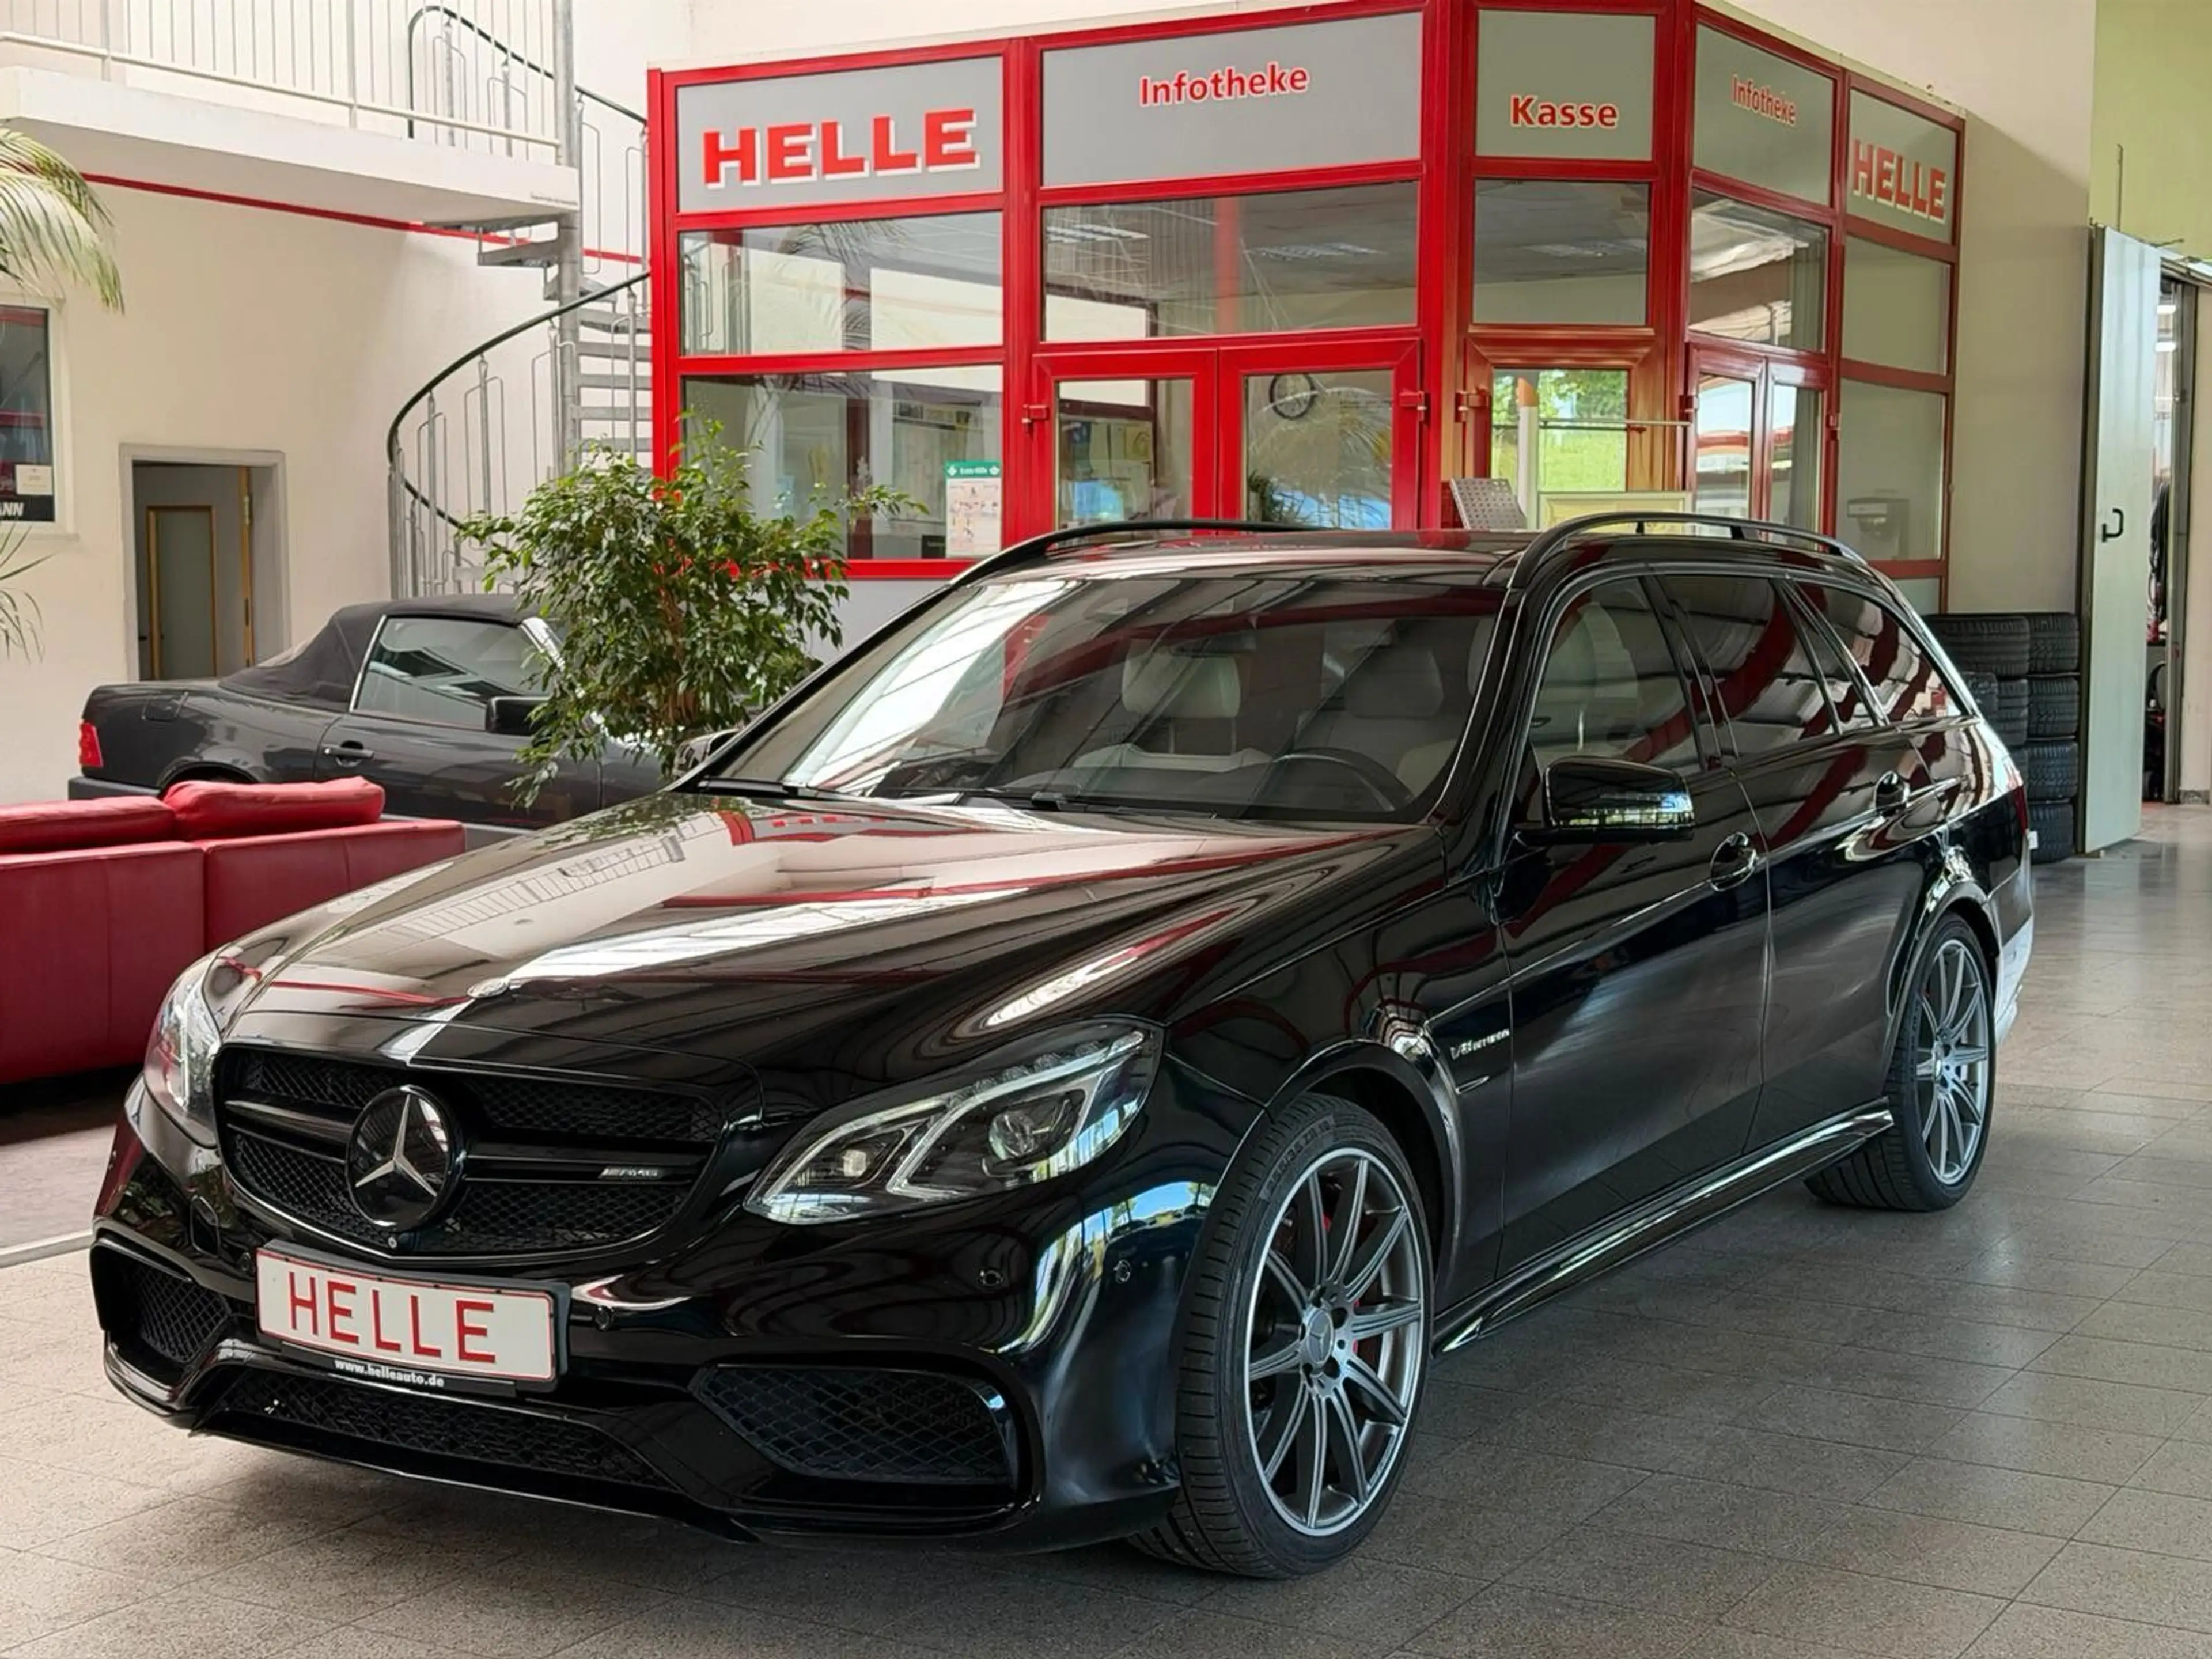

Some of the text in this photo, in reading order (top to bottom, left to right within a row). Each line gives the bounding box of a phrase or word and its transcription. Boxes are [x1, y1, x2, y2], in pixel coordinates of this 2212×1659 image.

[1140, 61, 1310, 107] Infotheke
[1732, 73, 1797, 127] Infotheke
[1510, 94, 1619, 129] Kasse
[703, 108, 980, 189] HELLE
[1853, 139, 1946, 225] HELLE
[289, 1271, 496, 1363] HELLE
[334, 1360, 444, 1387] www.helleauto.de
